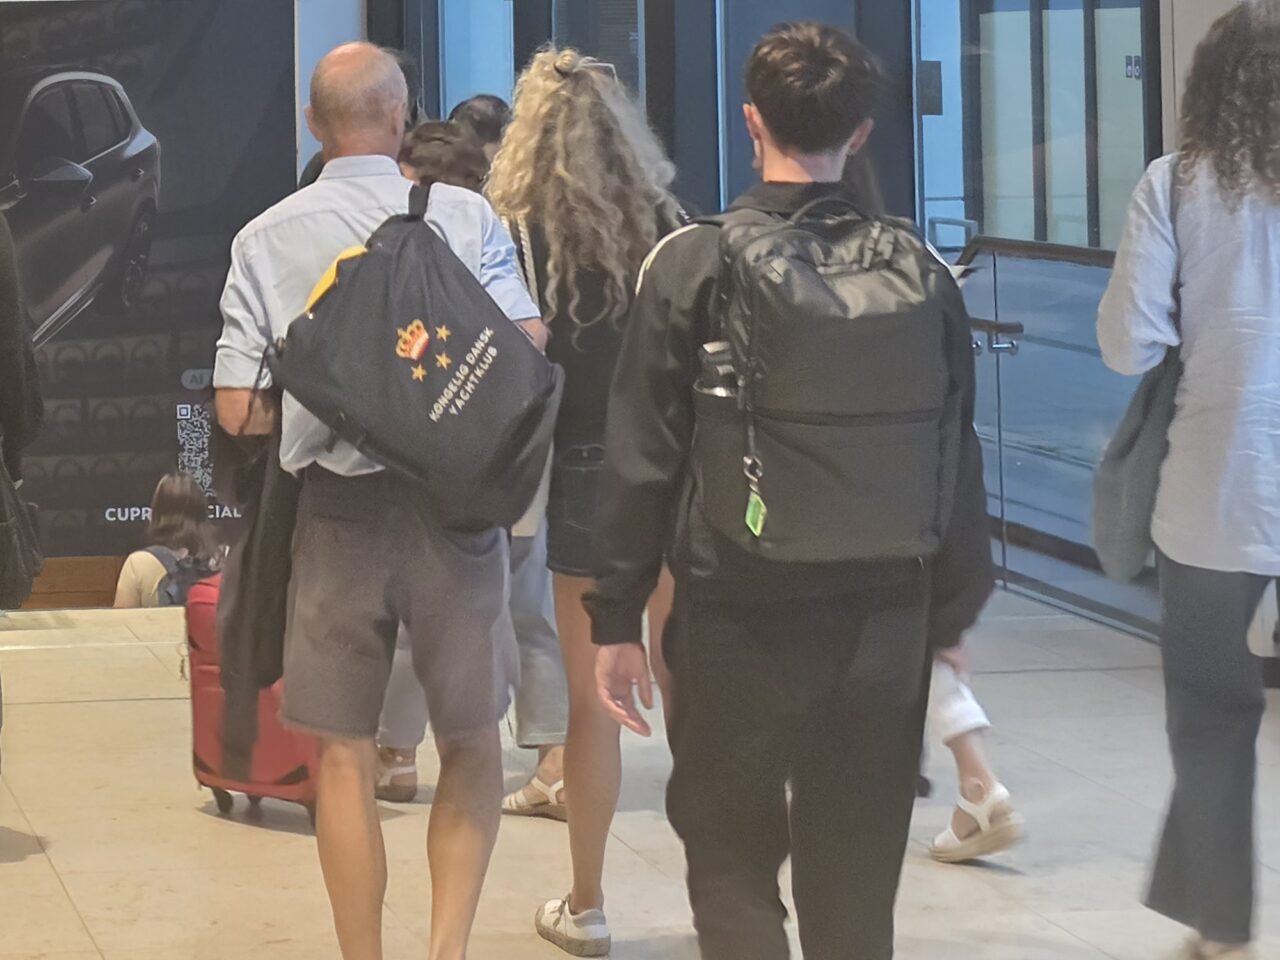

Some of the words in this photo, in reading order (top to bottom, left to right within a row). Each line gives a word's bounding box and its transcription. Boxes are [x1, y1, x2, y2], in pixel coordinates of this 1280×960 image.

[428, 363, 469, 423] KONGELIG
[465, 326, 494, 365] DANSK
[448, 345, 498, 415] YACHTKLUB
[104, 507, 153, 522] CUPR
